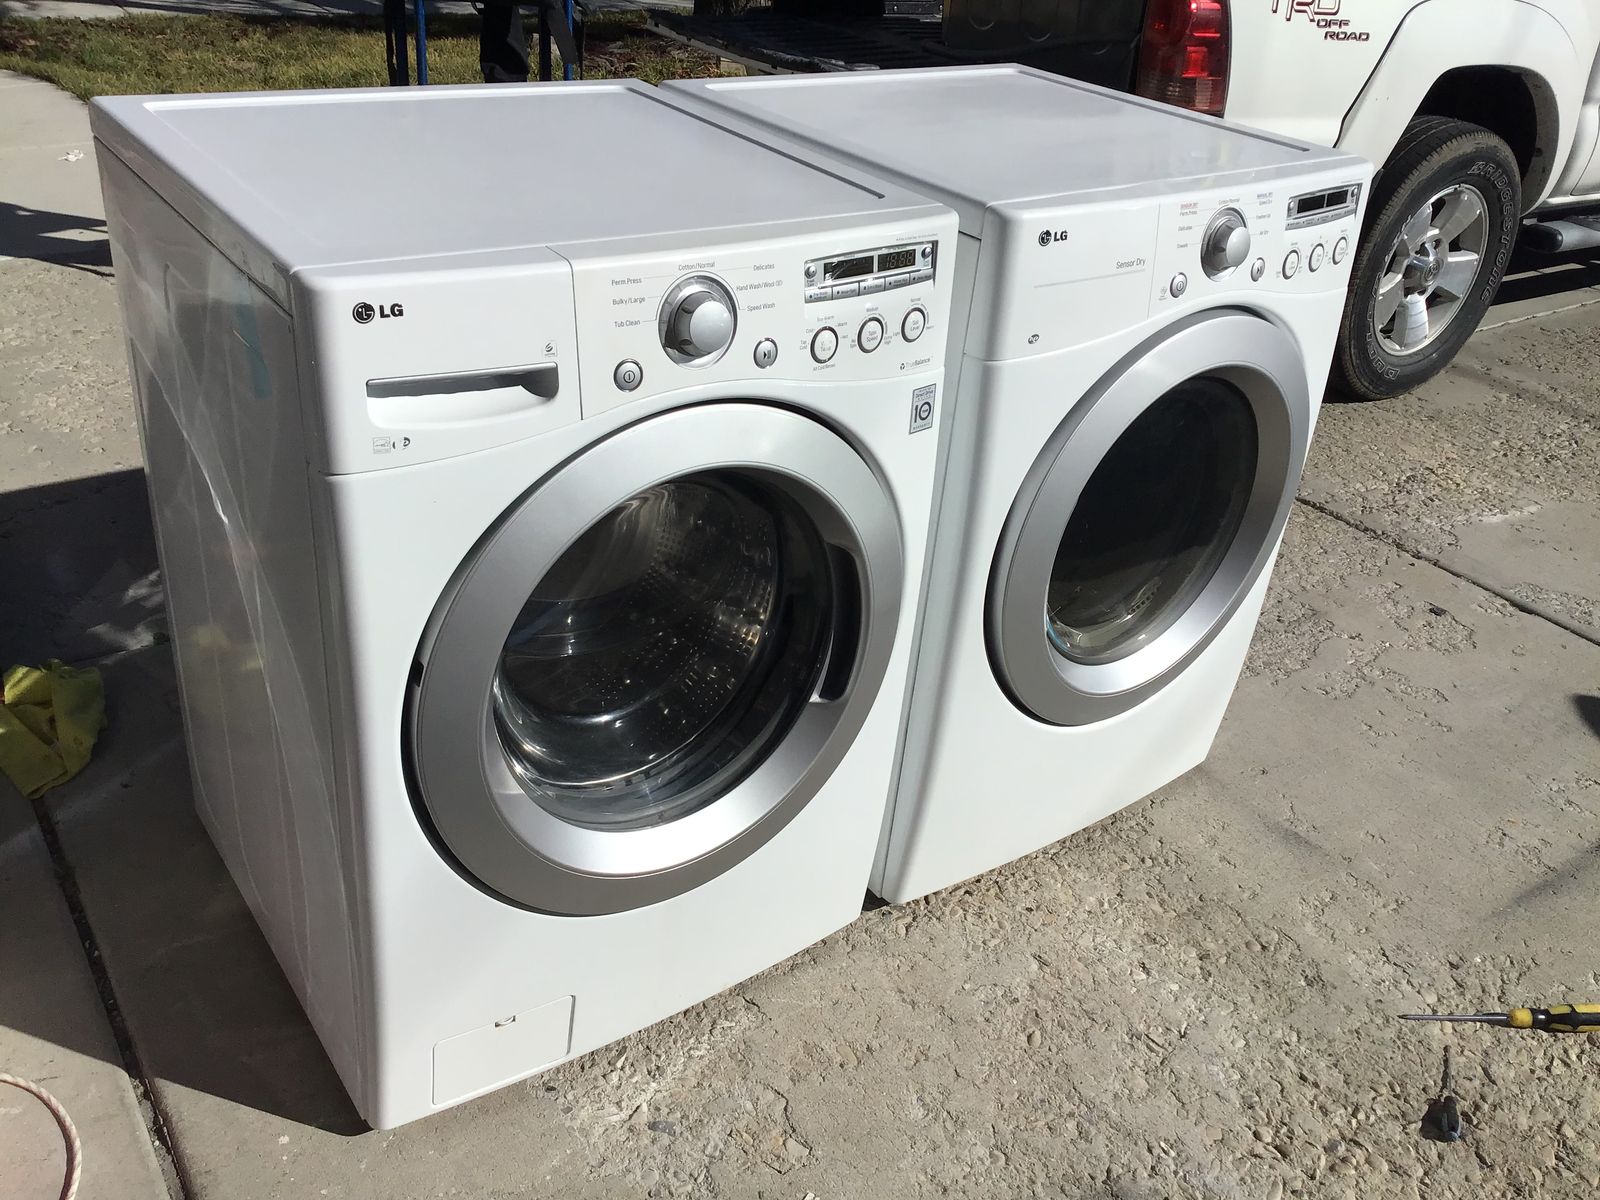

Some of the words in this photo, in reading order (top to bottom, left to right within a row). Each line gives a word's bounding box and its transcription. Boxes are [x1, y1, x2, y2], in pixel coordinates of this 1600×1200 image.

[1316, 19, 1350, 29] OFF
[1324, 31, 1370, 41] ROAD
[1053, 230, 1068, 242] LG
[678, 261, 716, 272] Cotton/Normal
[753, 263, 775, 271] Delicates
[1116, 259, 1136, 270] Sensor
[1136, 257, 1147, 267] Dry
[612, 296, 646, 306] Bulky/Large
[379, 303, 404, 319] LG
[614, 320, 625, 328] Tub
[625, 319, 641, 327] Clean
[914, 401, 932, 423] 10
